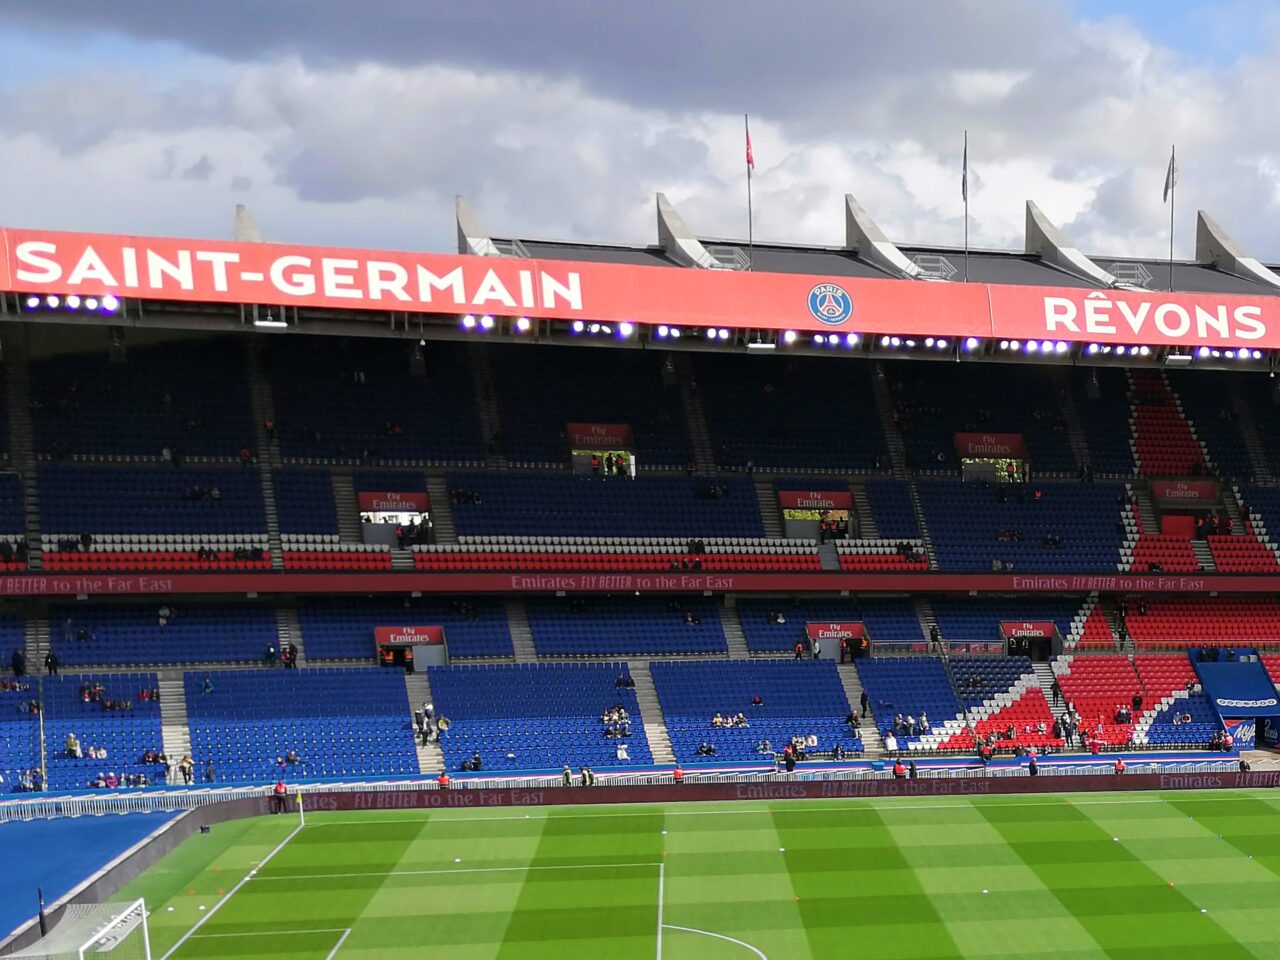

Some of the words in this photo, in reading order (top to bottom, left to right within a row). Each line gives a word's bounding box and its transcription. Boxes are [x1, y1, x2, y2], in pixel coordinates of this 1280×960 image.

[15, 241, 584, 310] SAINT-GERMAIN
[814, 285, 843, 297] PARIS
[1044, 291, 1266, 341] RÊVONS
[968, 443, 1010, 454] Emirates
[1166, 489, 1199, 498] Emirates
[372, 500, 416, 509] Emirates
[797, 498, 834, 507] Emirates
[7, 578, 47, 592] BETTER
[53, 579, 70, 592] to
[77, 578, 101, 592] the
[108, 578, 133, 591] Far
[140, 578, 172, 591] East
[511, 575, 576, 589] Emirates
[581, 577, 596, 588] FLY
[599, 577, 631, 588] BETTER
[637, 578, 650, 588] to
[656, 576, 676, 588] the
[681, 576, 701, 588] Far
[706, 576, 733, 588] East
[1013, 577, 1067, 589] Emirates
[1072, 577, 1086, 589] FLY
[1087, 577, 1116, 589] BETTER
[1119, 578, 1132, 589] to
[1136, 577, 1154, 589] the
[1159, 578, 1176, 589] Far
[1180, 578, 1204, 589] East
[390, 633, 429, 643] Emirates
[819, 629, 852, 638] Emirates
[1012, 628, 1044, 637] Emirates
[1160, 774, 1221, 788] Emirates
[1235, 774, 1251, 786] FLY
[737, 783, 807, 798] Emirates
[883, 783, 897, 795] to
[903, 780, 927, 794] the
[932, 780, 955, 794] Far
[960, 780, 990, 793] East
[355, 793, 376, 808] FLY
[378, 792, 416, 807] BETTER
[424, 793, 441, 806] to
[447, 791, 473, 806] the
[479, 792, 504, 805] Far
[511, 791, 545, 804] East
